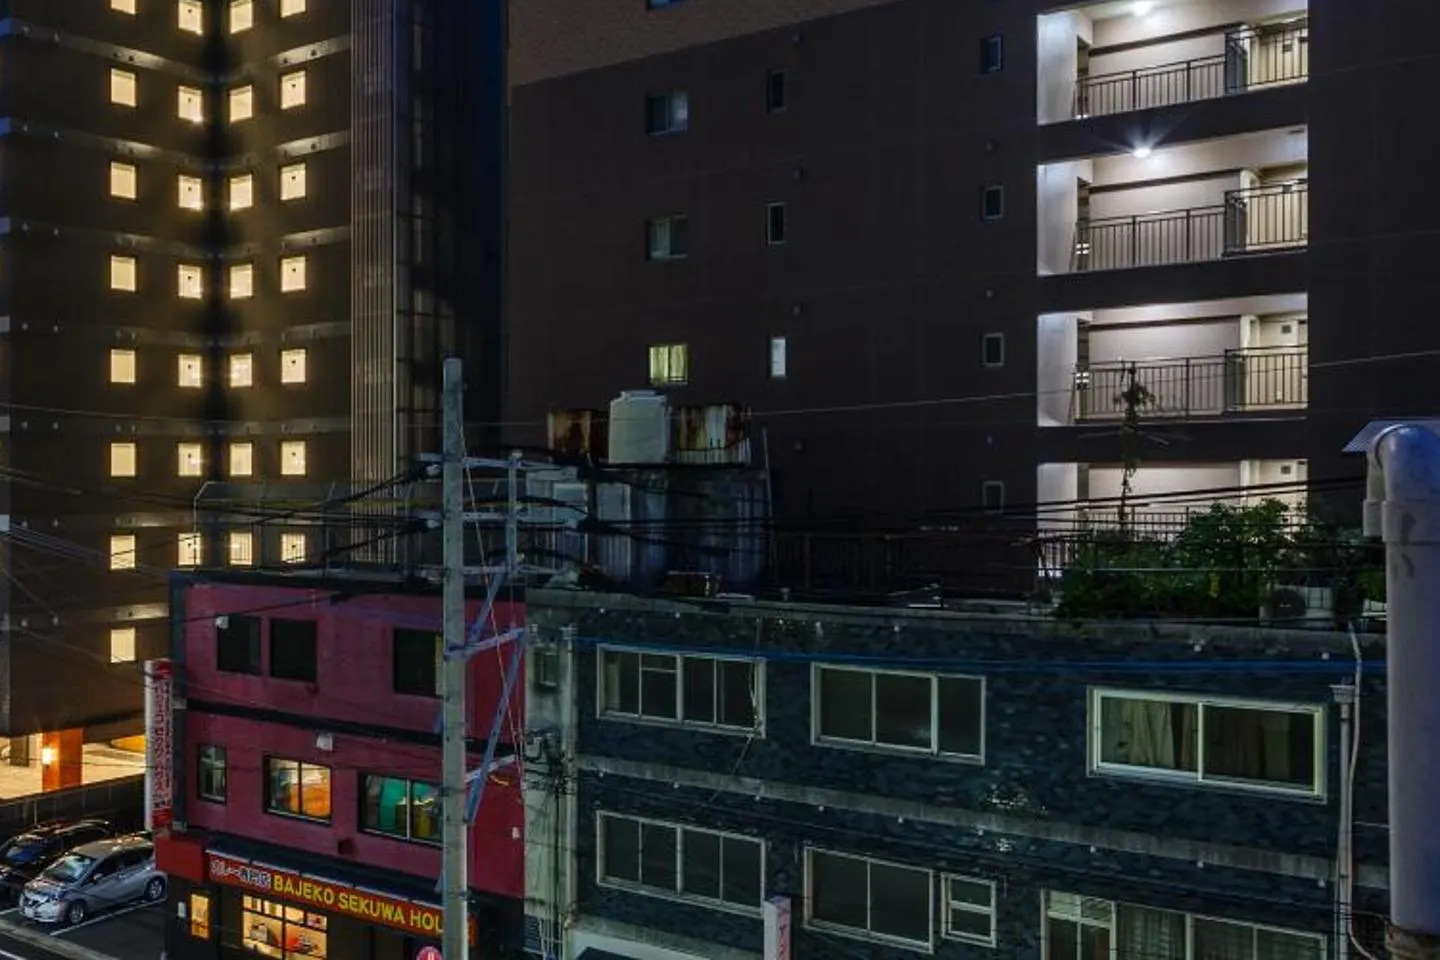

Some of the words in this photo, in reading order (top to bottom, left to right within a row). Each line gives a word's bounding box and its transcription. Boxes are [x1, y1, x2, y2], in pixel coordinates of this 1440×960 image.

[273, 874, 335, 905] BAJEKO
[338, 892, 406, 925] SEKUWA
[410, 913, 444, 934] HOU
